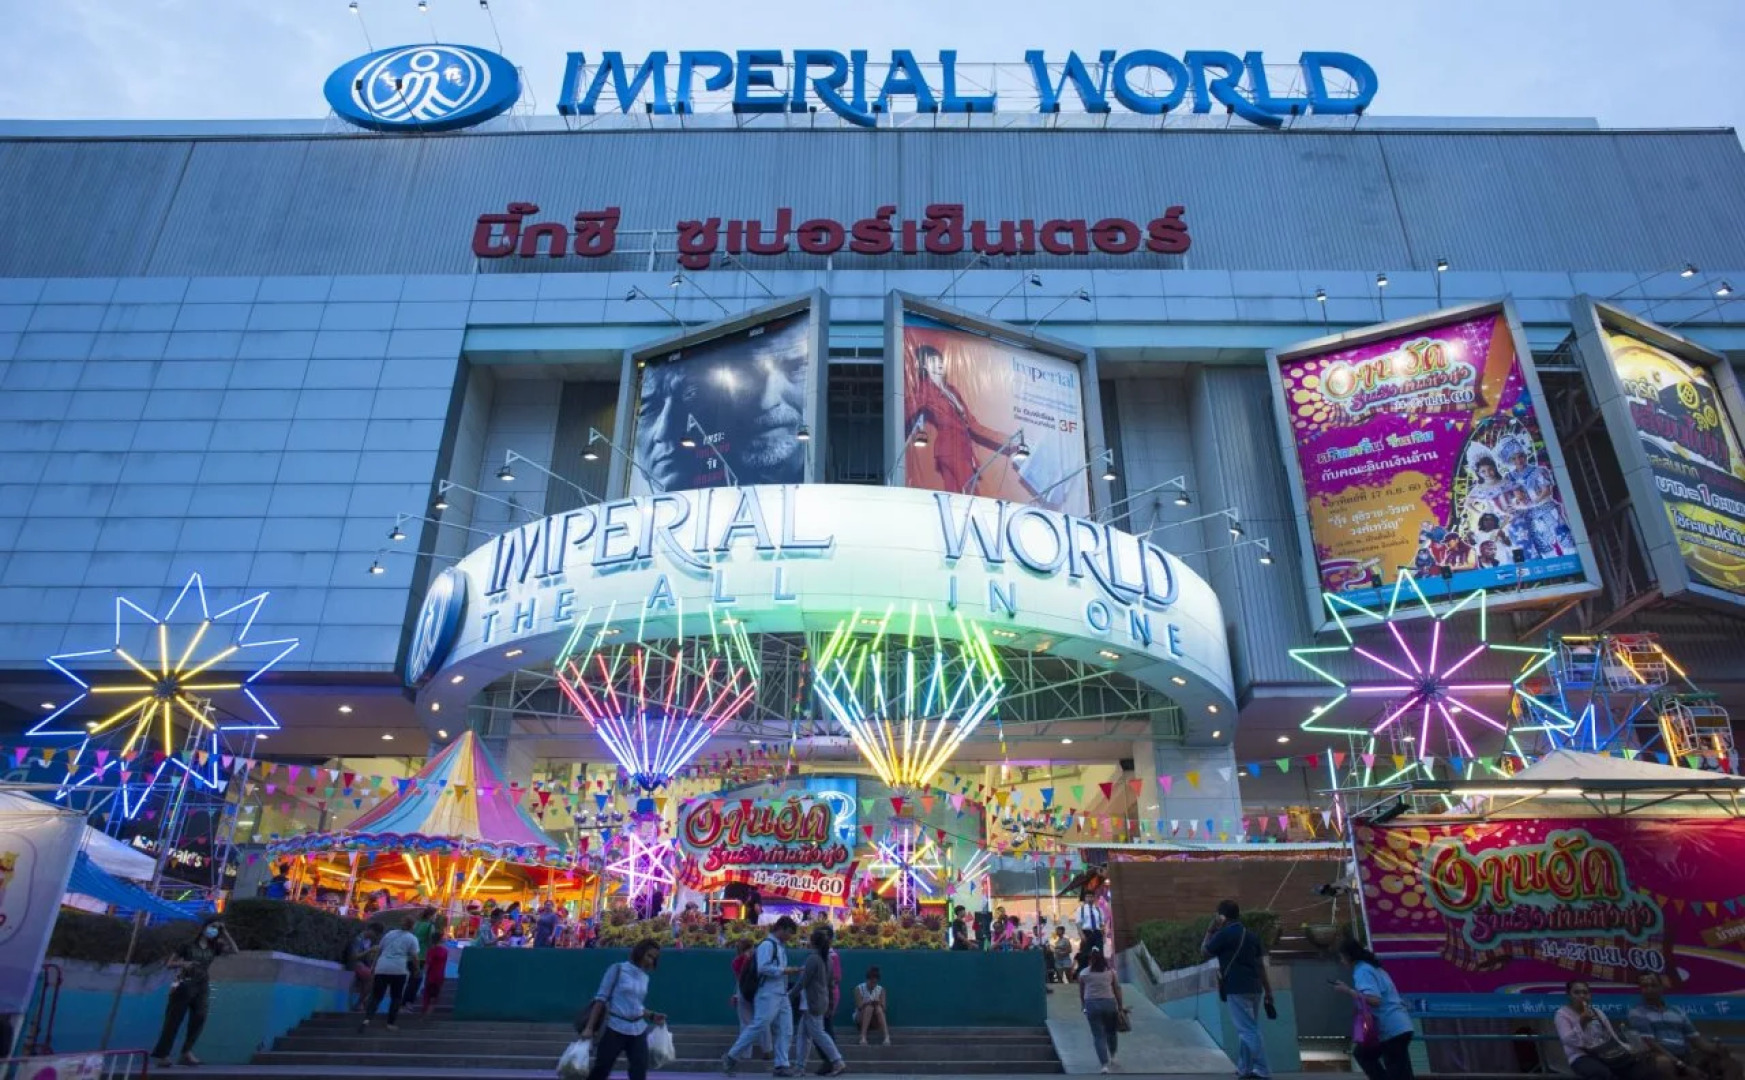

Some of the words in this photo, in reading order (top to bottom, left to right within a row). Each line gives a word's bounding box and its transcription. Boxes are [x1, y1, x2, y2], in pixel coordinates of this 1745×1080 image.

[558, 49, 996, 127] IMPERIAL
[1025, 49, 1379, 128] WORLD
[472, 202, 621, 258] บิ๊กซี
[677, 203, 1192, 271] ซูเปอร์เซ็นเตอร์
[1059, 419, 1077, 433] 3F
[484, 485, 835, 597] IMPERIAL
[933, 491, 1180, 607] WORLD
[480, 588, 577, 643] THE
[648, 567, 797, 609] ALL
[948, 574, 1016, 618] IN
[1086, 599, 1185, 660] ONE
[818, 877, 844, 896] 60
[1629, 947, 1664, 972] 60
